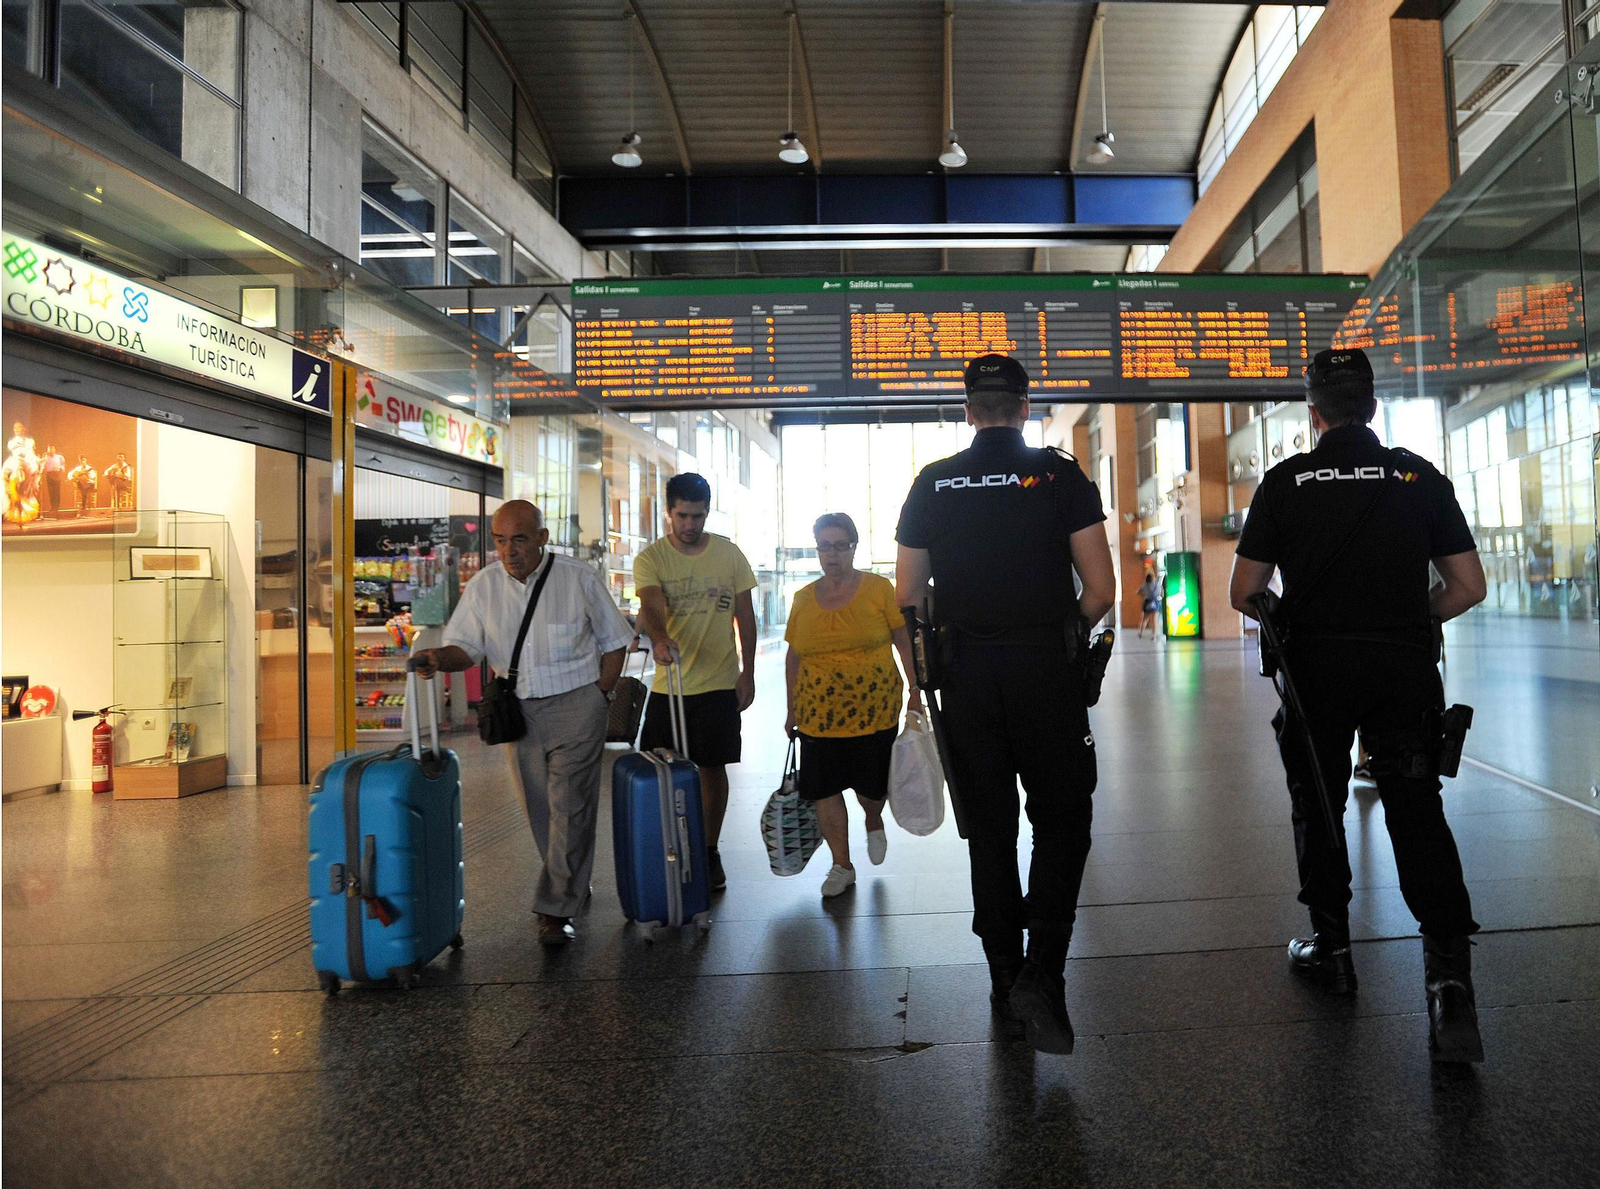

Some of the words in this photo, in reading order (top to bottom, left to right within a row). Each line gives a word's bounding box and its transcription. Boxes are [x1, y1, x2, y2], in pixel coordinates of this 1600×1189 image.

[574, 285, 605, 294] Salidas
[849, 280, 878, 289] Salidas
[1118, 279, 1152, 289] Llegadas
[8, 292, 147, 353] CÓRDOBA
[177, 313, 266, 359] INFORMACIÓN
[189, 344, 256, 380] TURÍSTICA
[1331, 355, 1351, 363] CNP
[386, 397, 467, 454] sweety
[934, 473, 1021, 492] POLICIA
